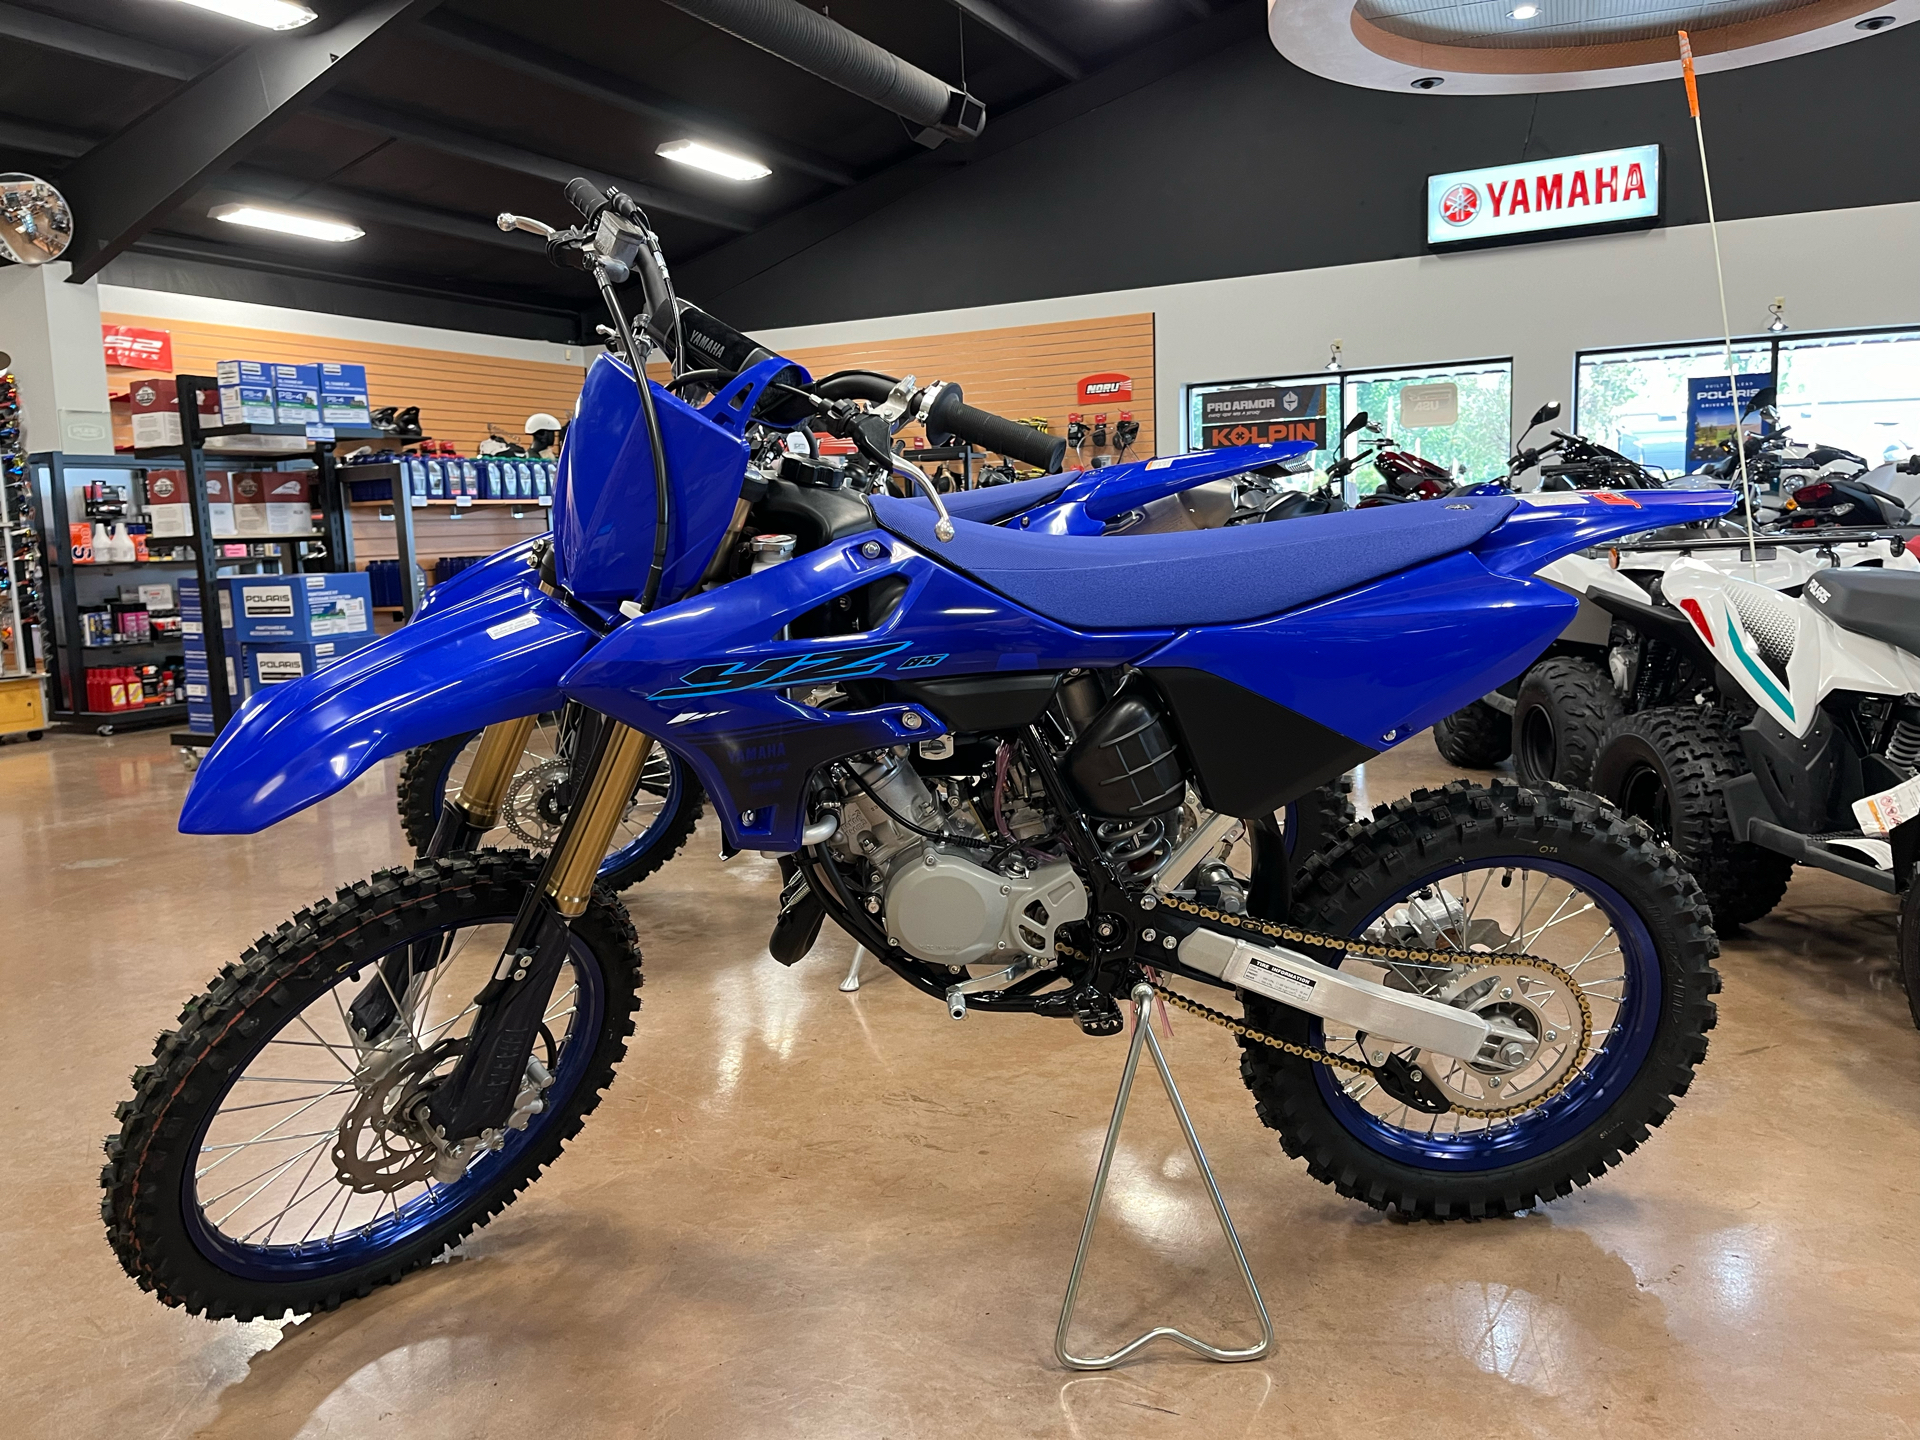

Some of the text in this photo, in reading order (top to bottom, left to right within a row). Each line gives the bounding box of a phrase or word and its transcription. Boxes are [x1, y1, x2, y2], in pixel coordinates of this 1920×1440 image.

[1486, 162, 1647, 218] YAMAHA
[690, 329, 726, 359] YAMAHA
[1086, 382, 1121, 394] NORU
[1696, 388, 1760, 401] POLARIS
[1212, 422, 1316, 446] KOLPIN
[245, 594, 290, 603] POLARIS
[1807, 578, 1832, 604] POLARIS
[259, 660, 301, 669] POLARIS
[896, 653, 950, 670] 85
[727, 741, 787, 765] YAMAHA
[1256, 960, 1270, 970] TIRE
[1271, 966, 1311, 985] INFORMATION
